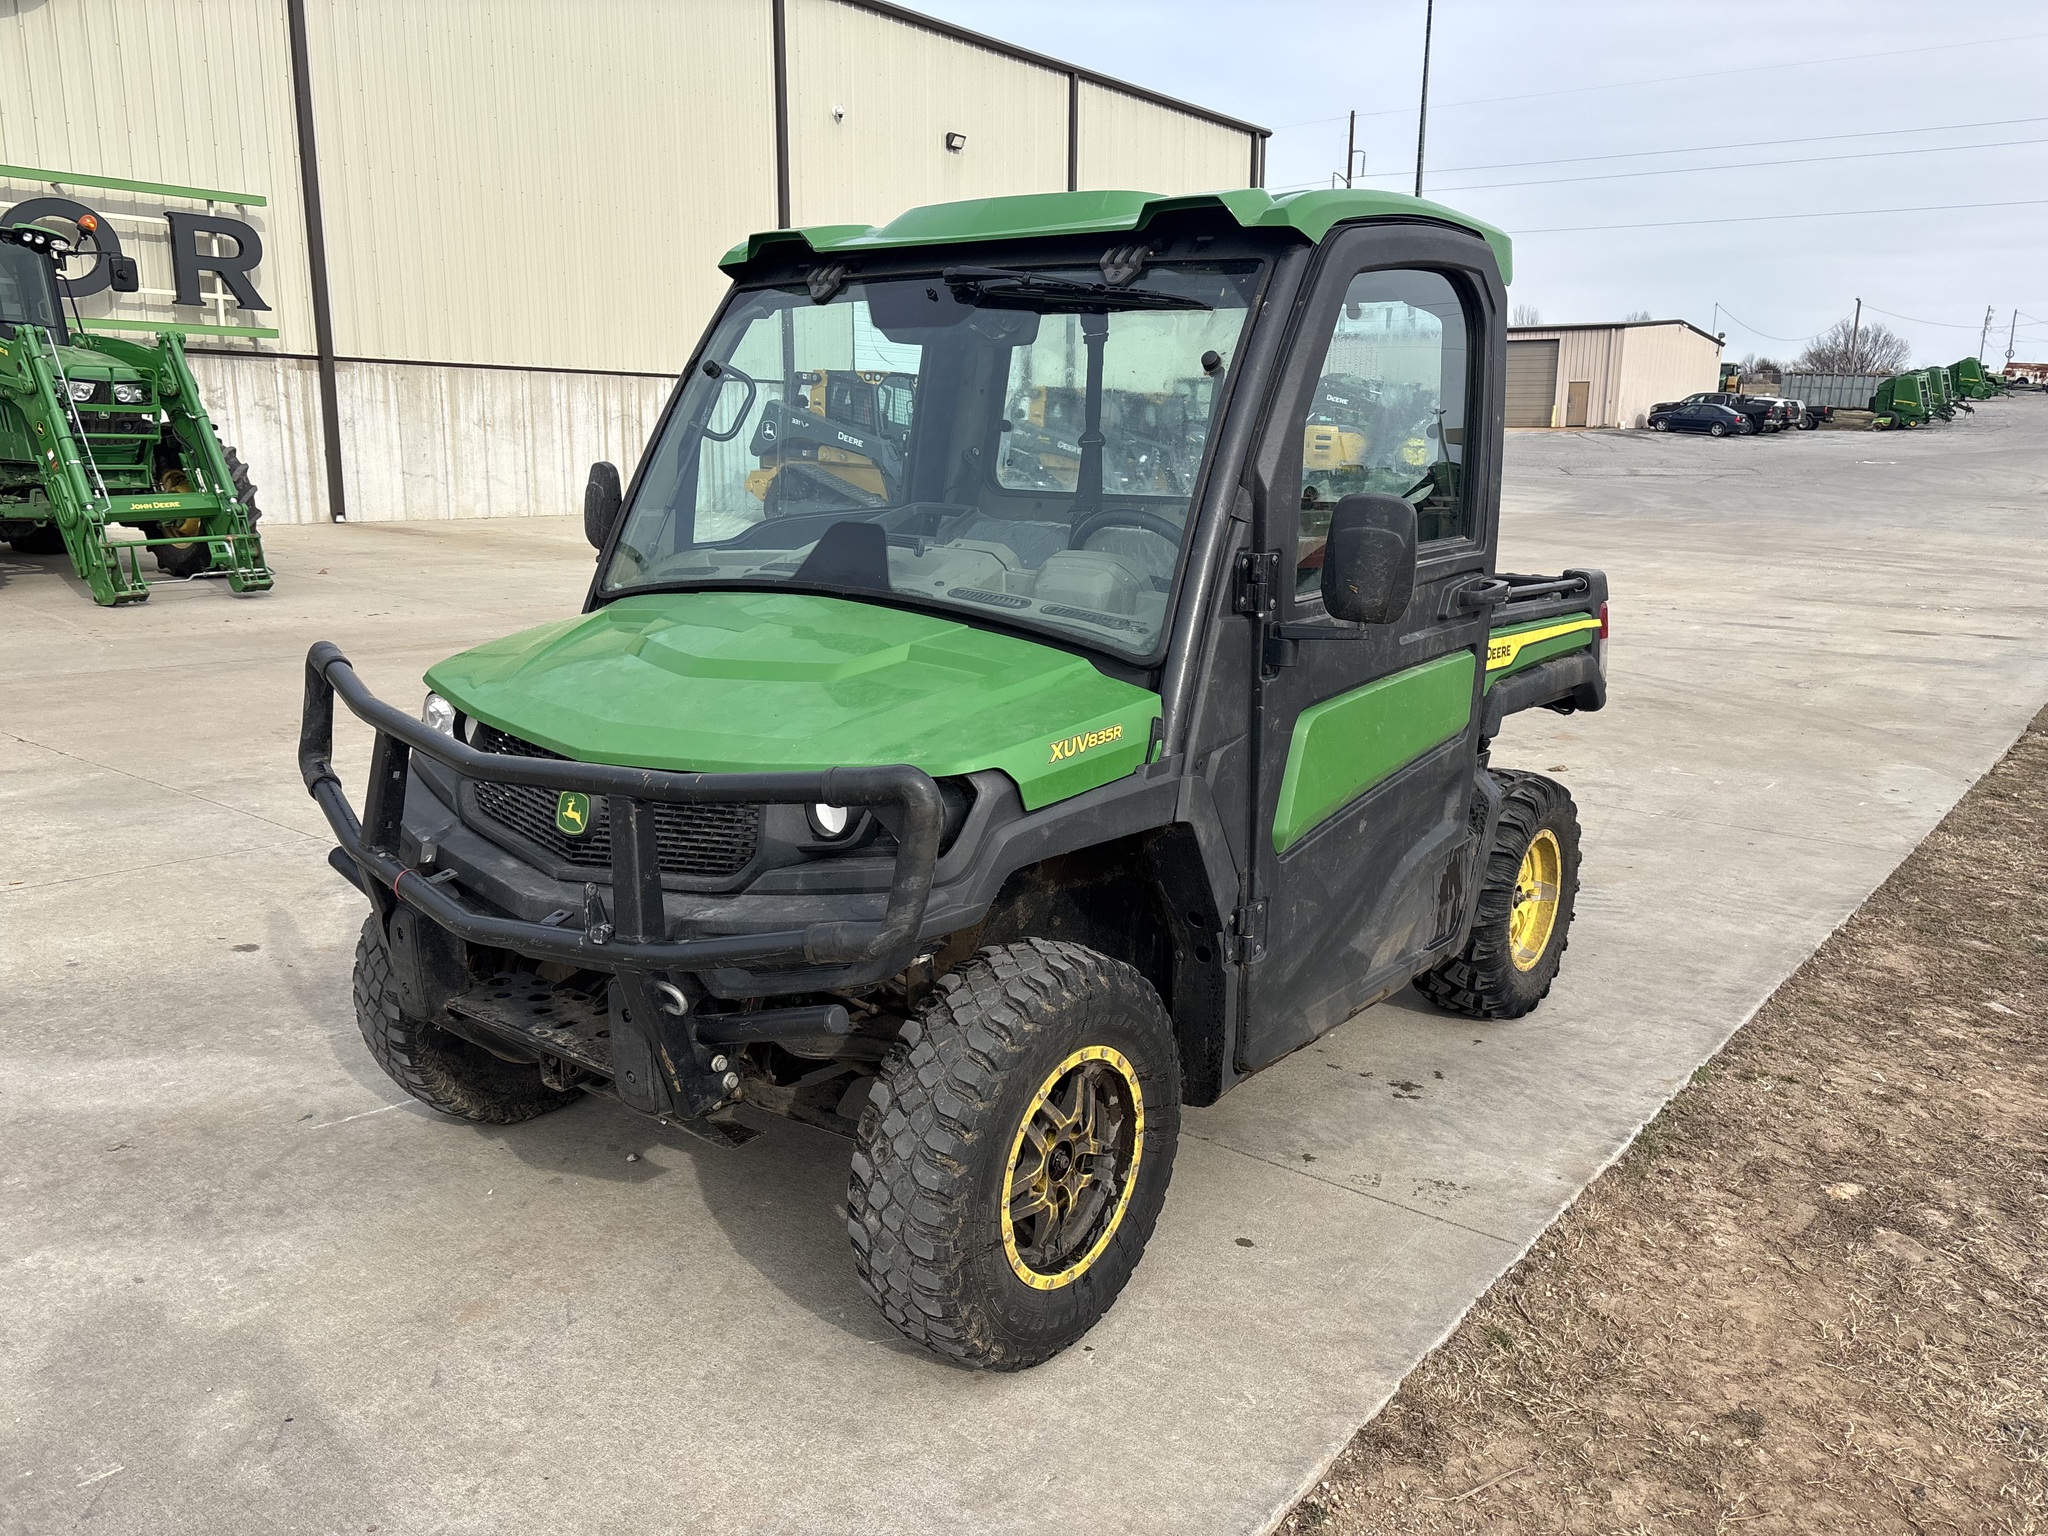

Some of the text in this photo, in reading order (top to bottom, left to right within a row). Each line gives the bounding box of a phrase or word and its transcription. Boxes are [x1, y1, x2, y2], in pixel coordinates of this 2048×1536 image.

[1326, 394, 1349, 405] DEERE
[838, 431, 863, 447] DEERE
[130, 501, 181, 511] JOHN DEERE
[1487, 645, 1511, 660] DEERE
[1049, 725, 1123, 763] XUV835R
